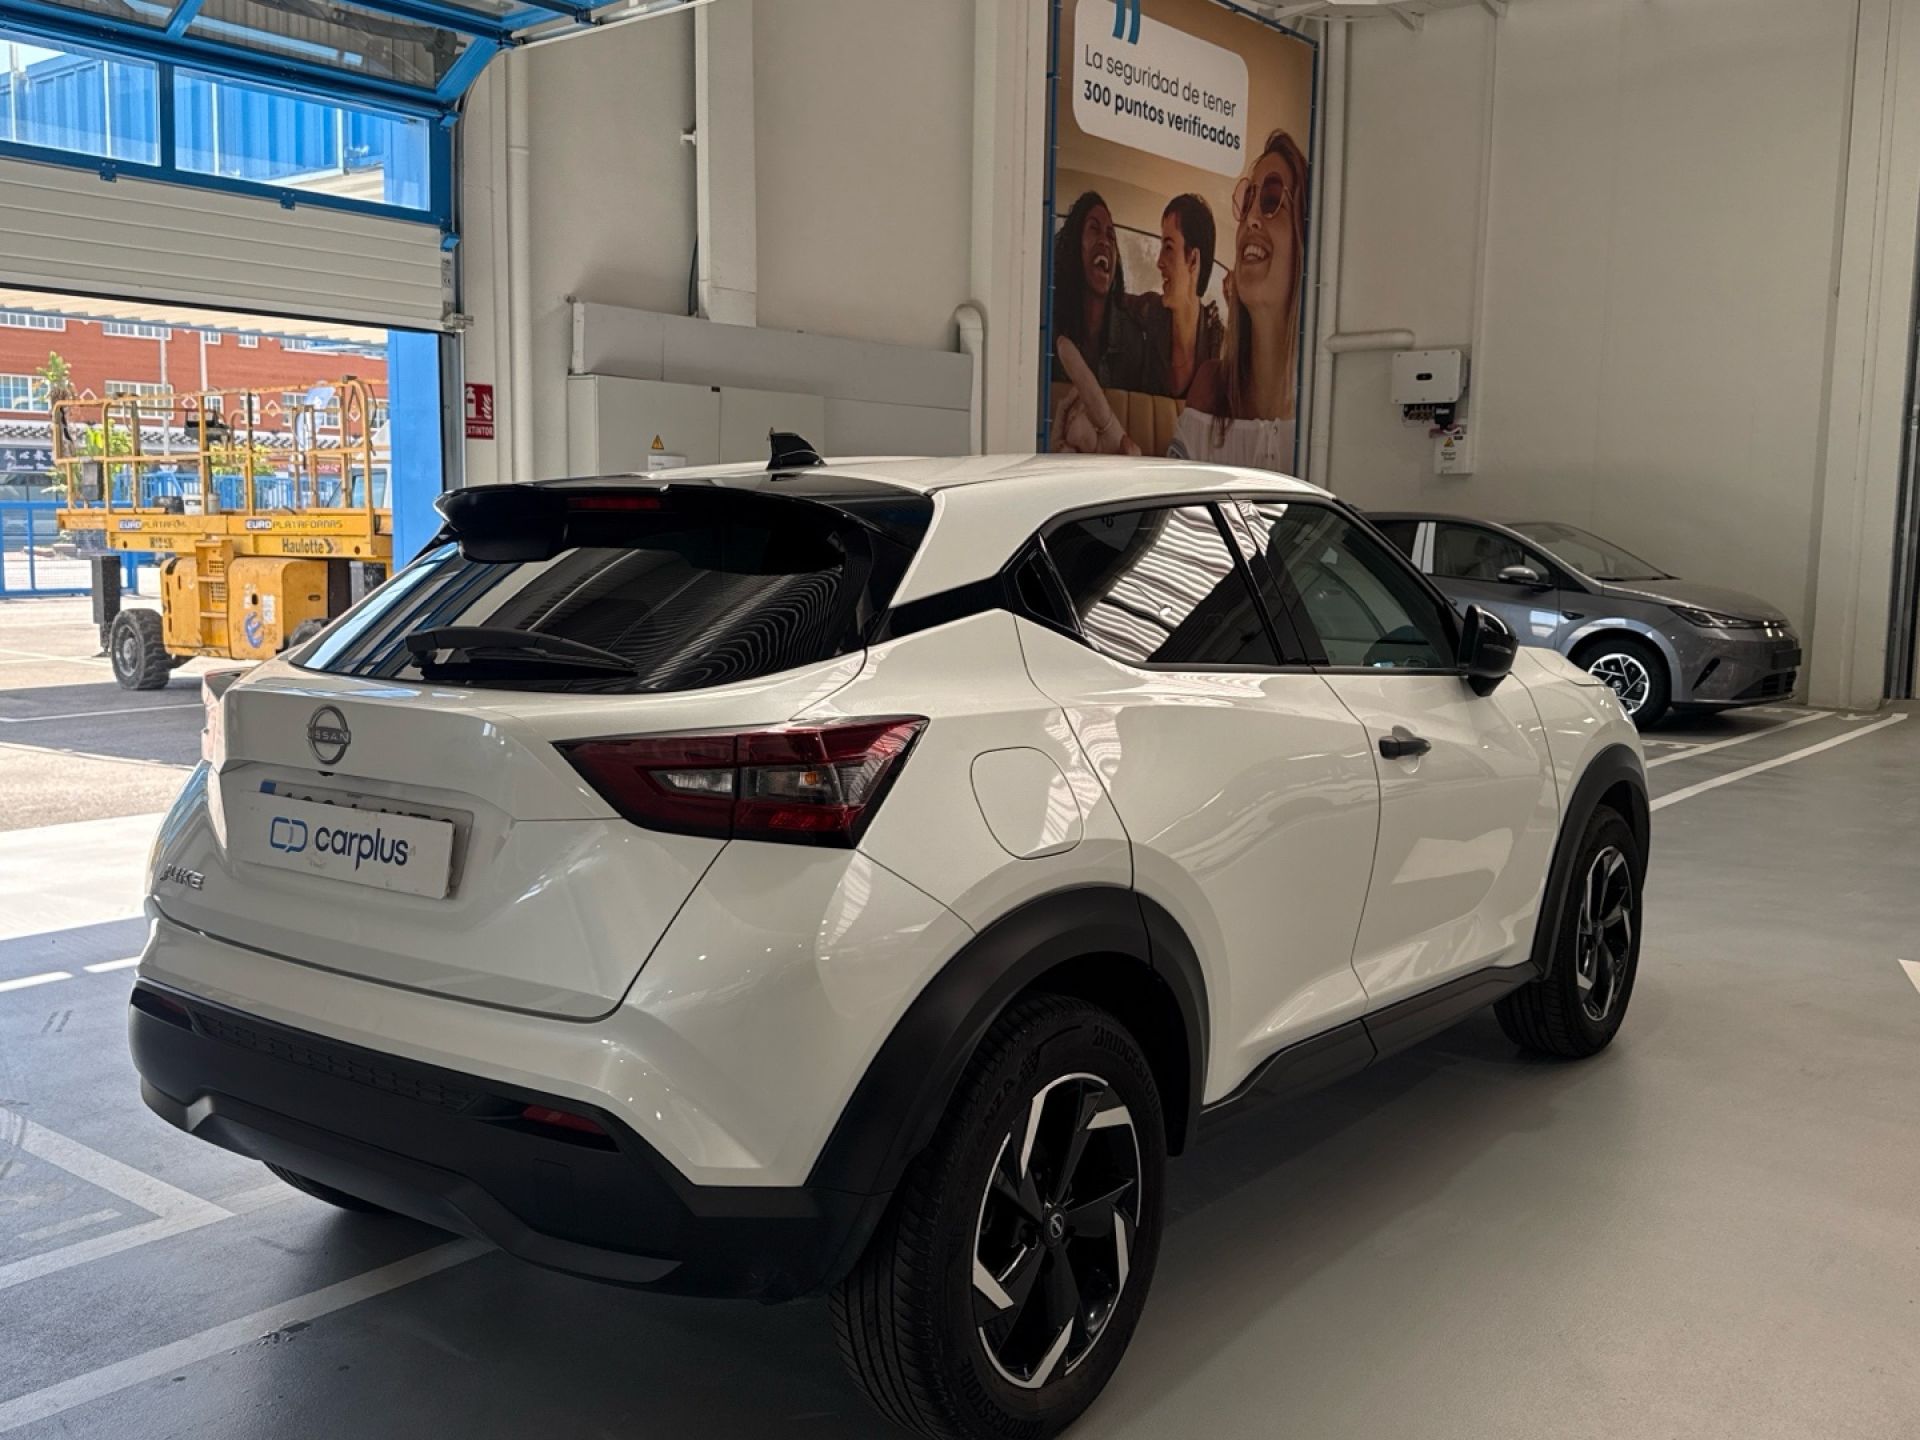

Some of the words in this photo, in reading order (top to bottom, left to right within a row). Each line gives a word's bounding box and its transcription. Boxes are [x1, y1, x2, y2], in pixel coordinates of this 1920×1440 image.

[1084, 44, 1103, 69] La
[1106, 56, 1180, 97] seguridad
[1181, 81, 1200, 105] de
[1203, 90, 1237, 118] tener
[1083, 80, 1112, 106] 300
[1115, 93, 1164, 125] puntos
[1167, 111, 1241, 150] verificados
[282, 538, 325, 554] Haulotte
[315, 826, 408, 871] carplus
